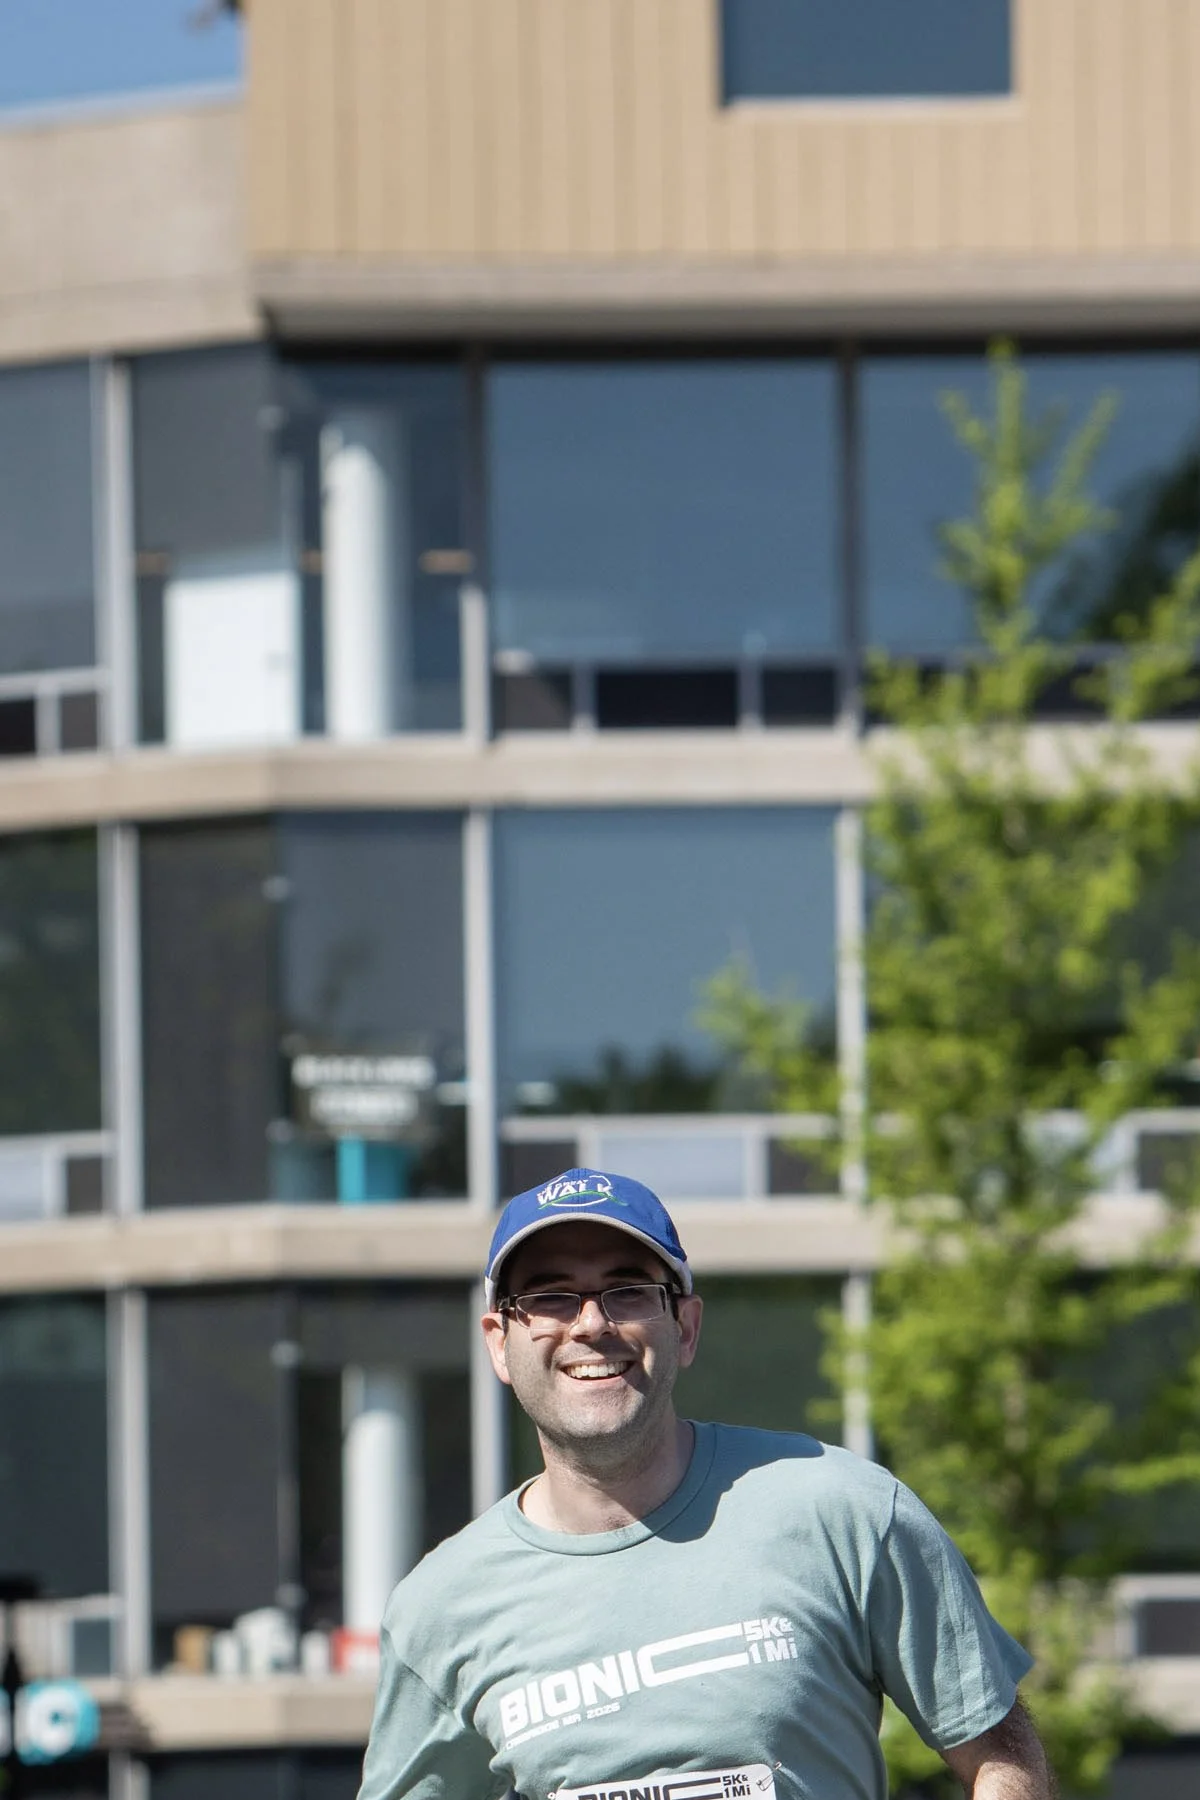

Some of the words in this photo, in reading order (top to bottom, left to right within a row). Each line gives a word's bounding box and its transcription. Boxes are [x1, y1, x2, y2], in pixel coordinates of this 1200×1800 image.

[742, 1616, 794, 1642] 5K&
[500, 1622, 749, 1738] BIONIC
[722, 1773, 749, 1787] 5K&
